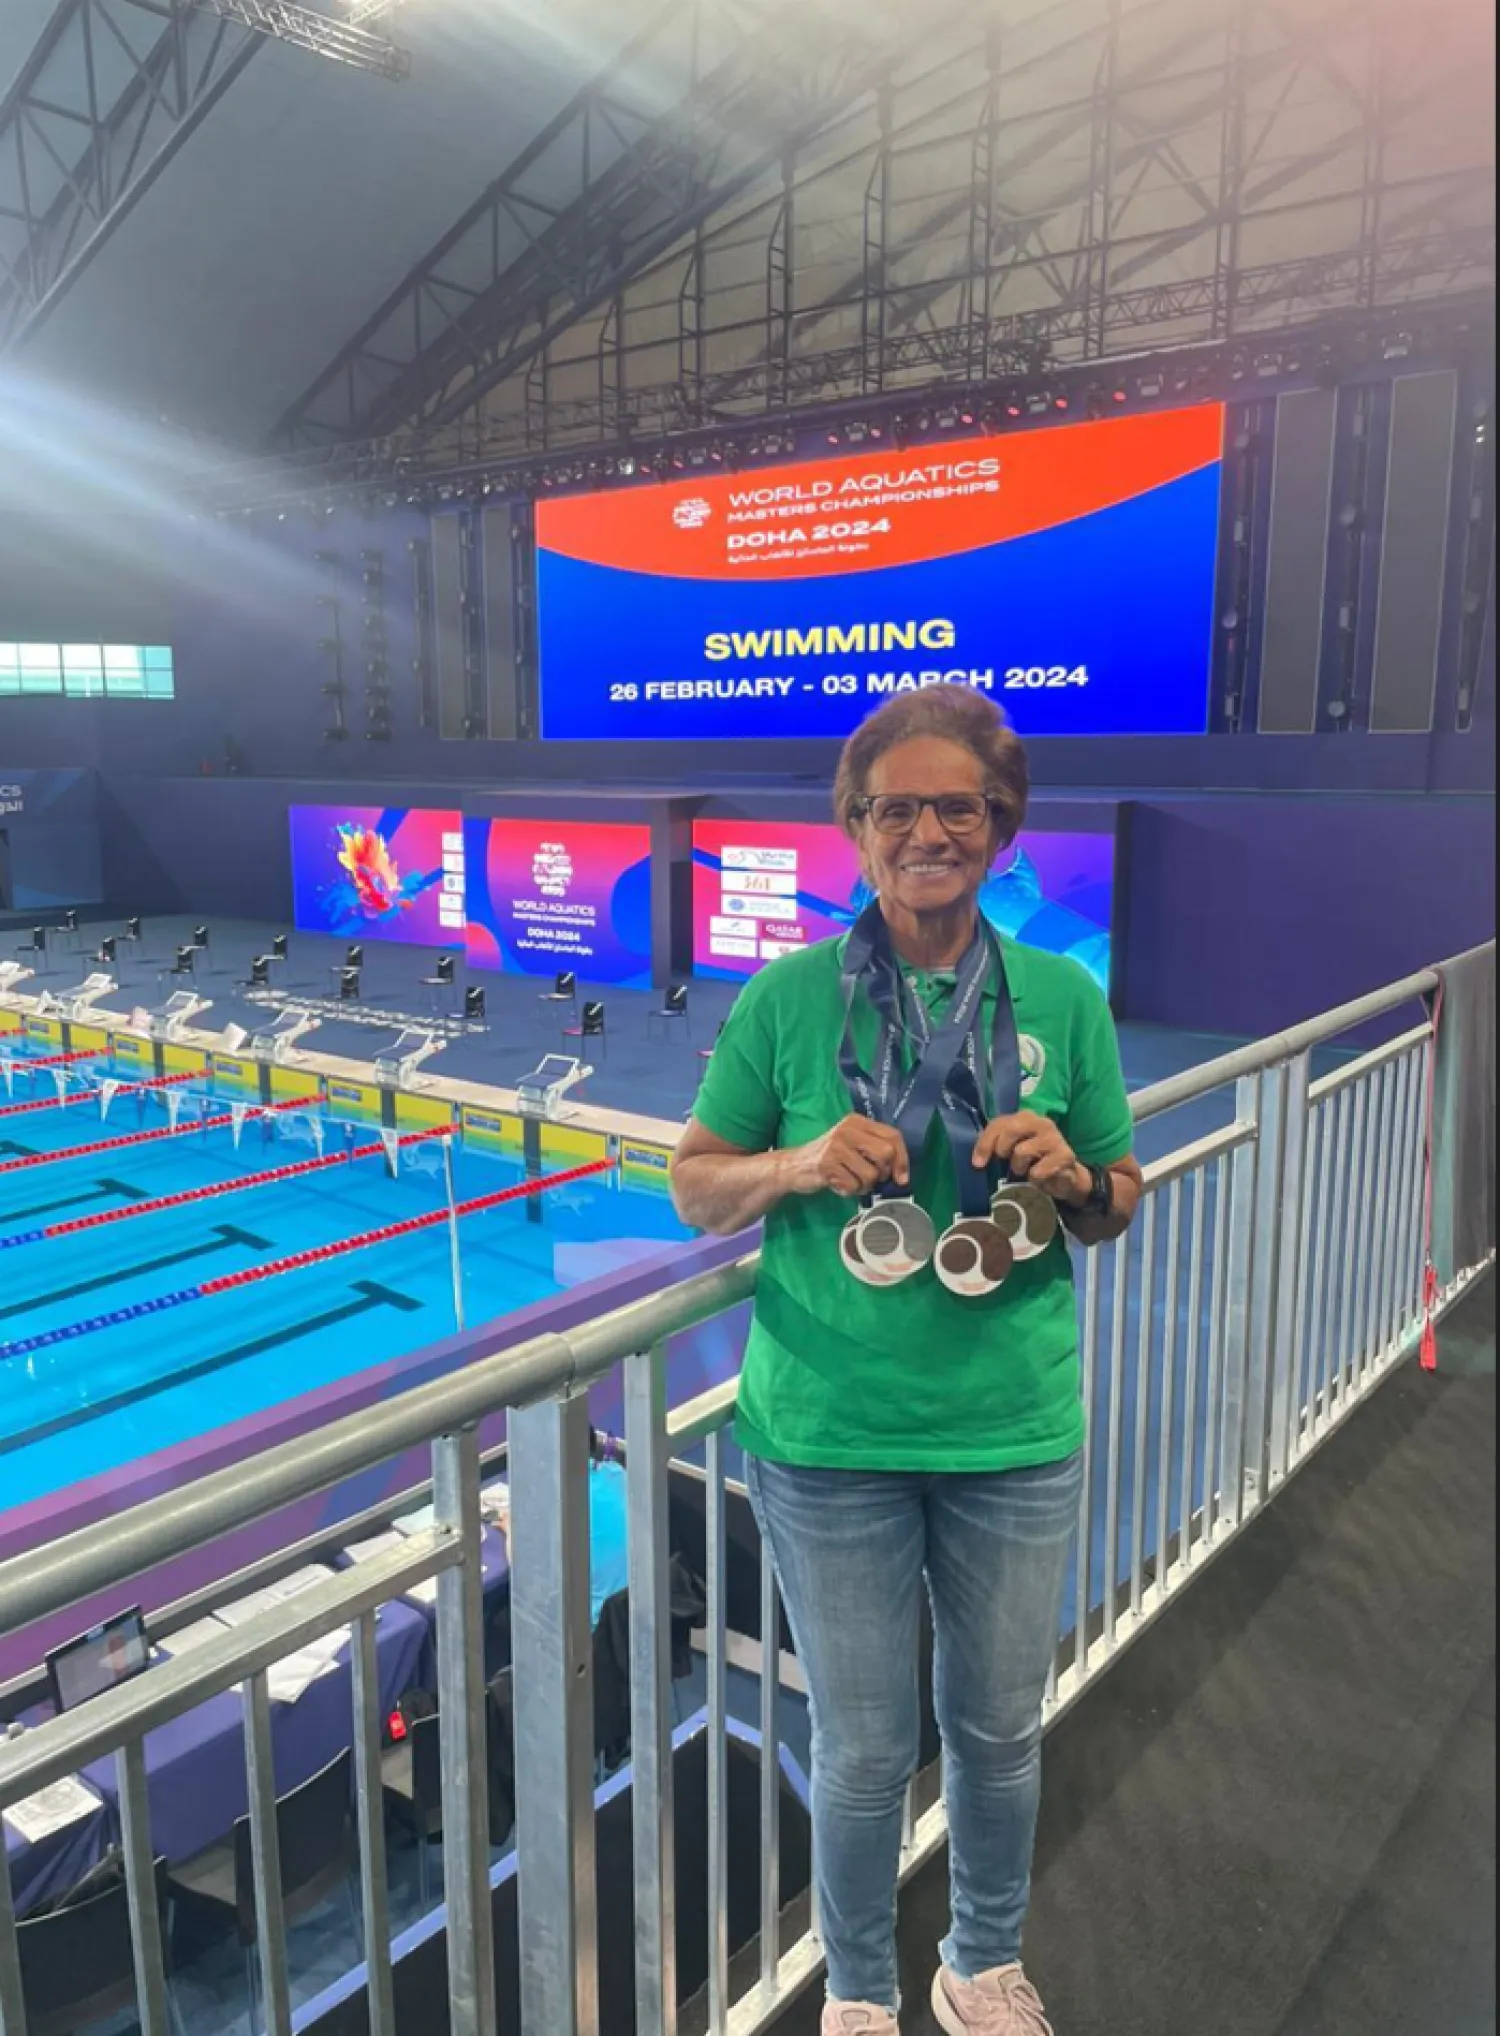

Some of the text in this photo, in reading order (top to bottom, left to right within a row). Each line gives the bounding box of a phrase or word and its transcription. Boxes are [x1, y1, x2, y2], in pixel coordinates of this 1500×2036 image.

[726, 479, 1000, 524] MASTERS CHAMPIONSHIPS
[728, 457, 1001, 508] WORLD AQUATICS
[726, 516, 892, 549] DOHA 2024
[704, 617, 956, 662] SWIMMING
[608, 681, 639, 702] 26
[644, 675, 795, 701] FEBRUARY
[821, 674, 858, 695] 03
[1003, 664, 1090, 690] 2024
